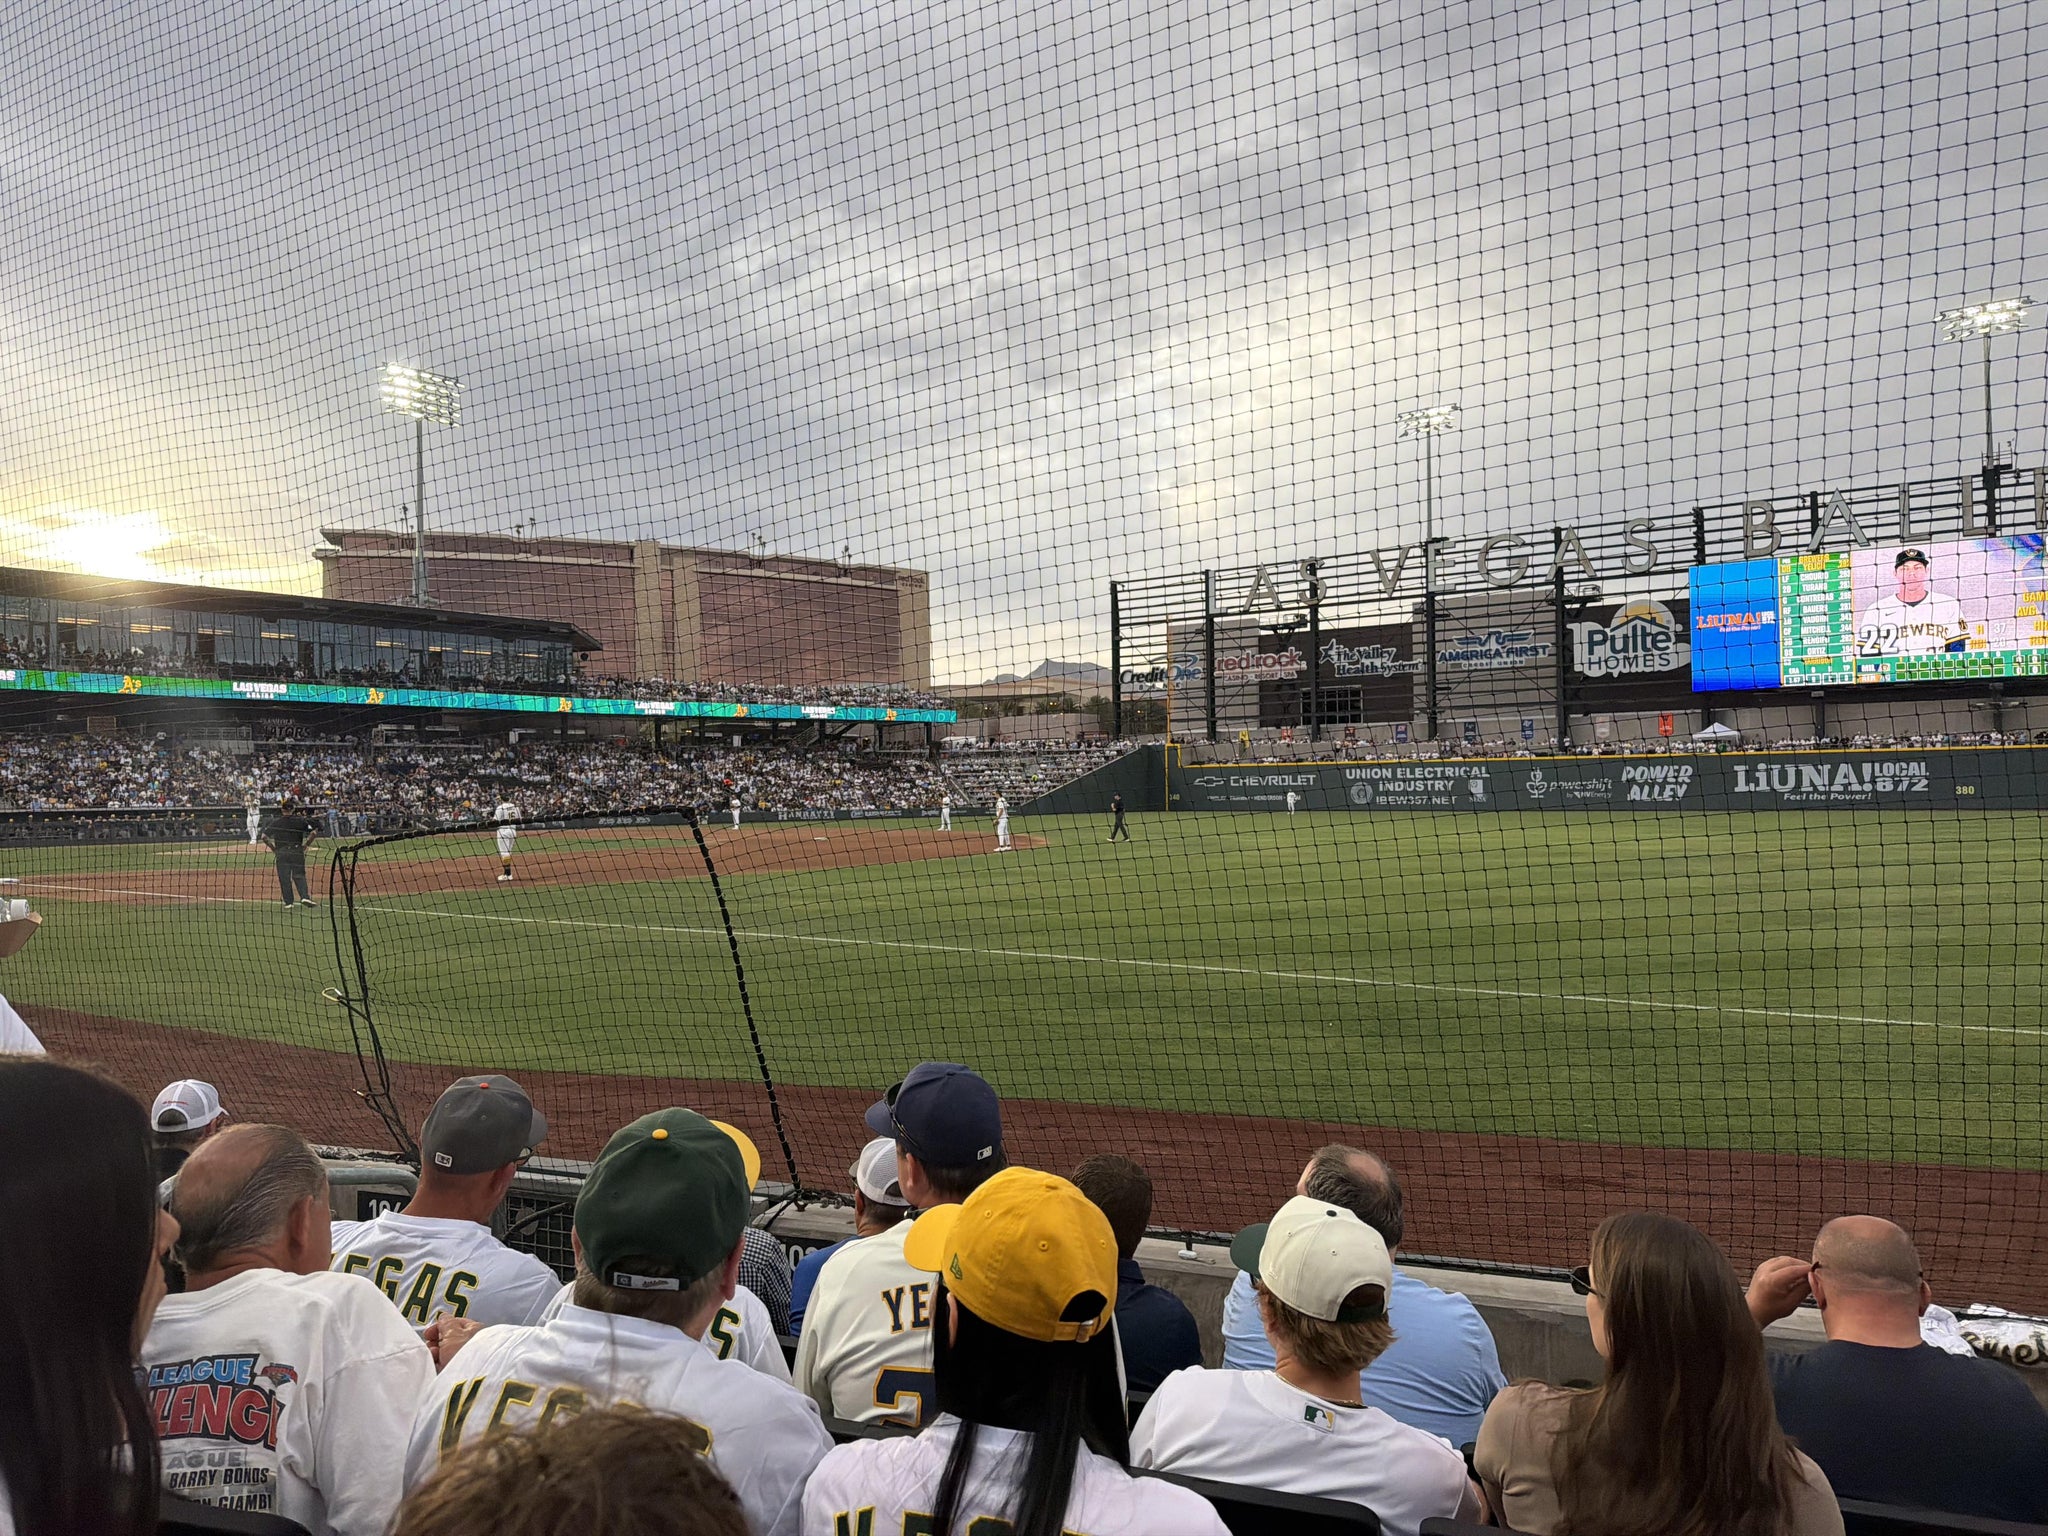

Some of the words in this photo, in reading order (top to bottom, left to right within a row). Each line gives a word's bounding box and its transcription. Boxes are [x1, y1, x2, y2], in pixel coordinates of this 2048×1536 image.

[1207, 557, 1328, 615] LAS
[1369, 517, 1659, 600] VEGAS
[2022, 592, 2048, 602] GAM
[2017, 605, 2037, 616] AVG
[1696, 612, 1762, 630] LiUNA!
[1993, 623, 2007, 633] 37
[1587, 622, 1672, 656] Pulte
[1859, 622, 1899, 657] 22
[1216, 652, 1252, 671] red
[1255, 647, 1302, 670] rock
[1335, 648, 1356, 661] The
[1356, 646, 1396, 662] Valley
[1437, 647, 1503, 662] AMERICA
[1505, 644, 1551, 657] FIRST
[1587, 652, 1671, 671] HOMES
[1335, 661, 1380, 677] Health
[1380, 660, 1421, 677] System
[119, 675, 142, 694] A's
[232, 682, 253, 692] LAS
[254, 683, 288, 693] VEGAS
[366, 688, 385, 704] A's
[1229, 774, 1317, 786] CHEVROLET
[1345, 767, 1392, 779] UNION
[1396, 766, 1490, 778] ELECTRICAL
[1620, 764, 1694, 784] POWER
[1733, 762, 1873, 793] LiUNA!
[1874, 761, 1930, 777] LOCAL
[1549, 777, 1613, 791] powershift
[1626, 783, 1689, 802] ALLEY
[1874, 777, 1930, 792] 872
[1955, 785, 1976, 795] 380
[1784, 793, 1807, 801] Feel
[1808, 793, 1827, 801] the
[1830, 792, 1872, 800] Power!
[149, 1358, 254, 1388] LEAGUE
[165, 1451, 243, 1469] AGUE
[169, 1469, 218, 1489] BARRY
[222, 1467, 270, 1486] BONDS
